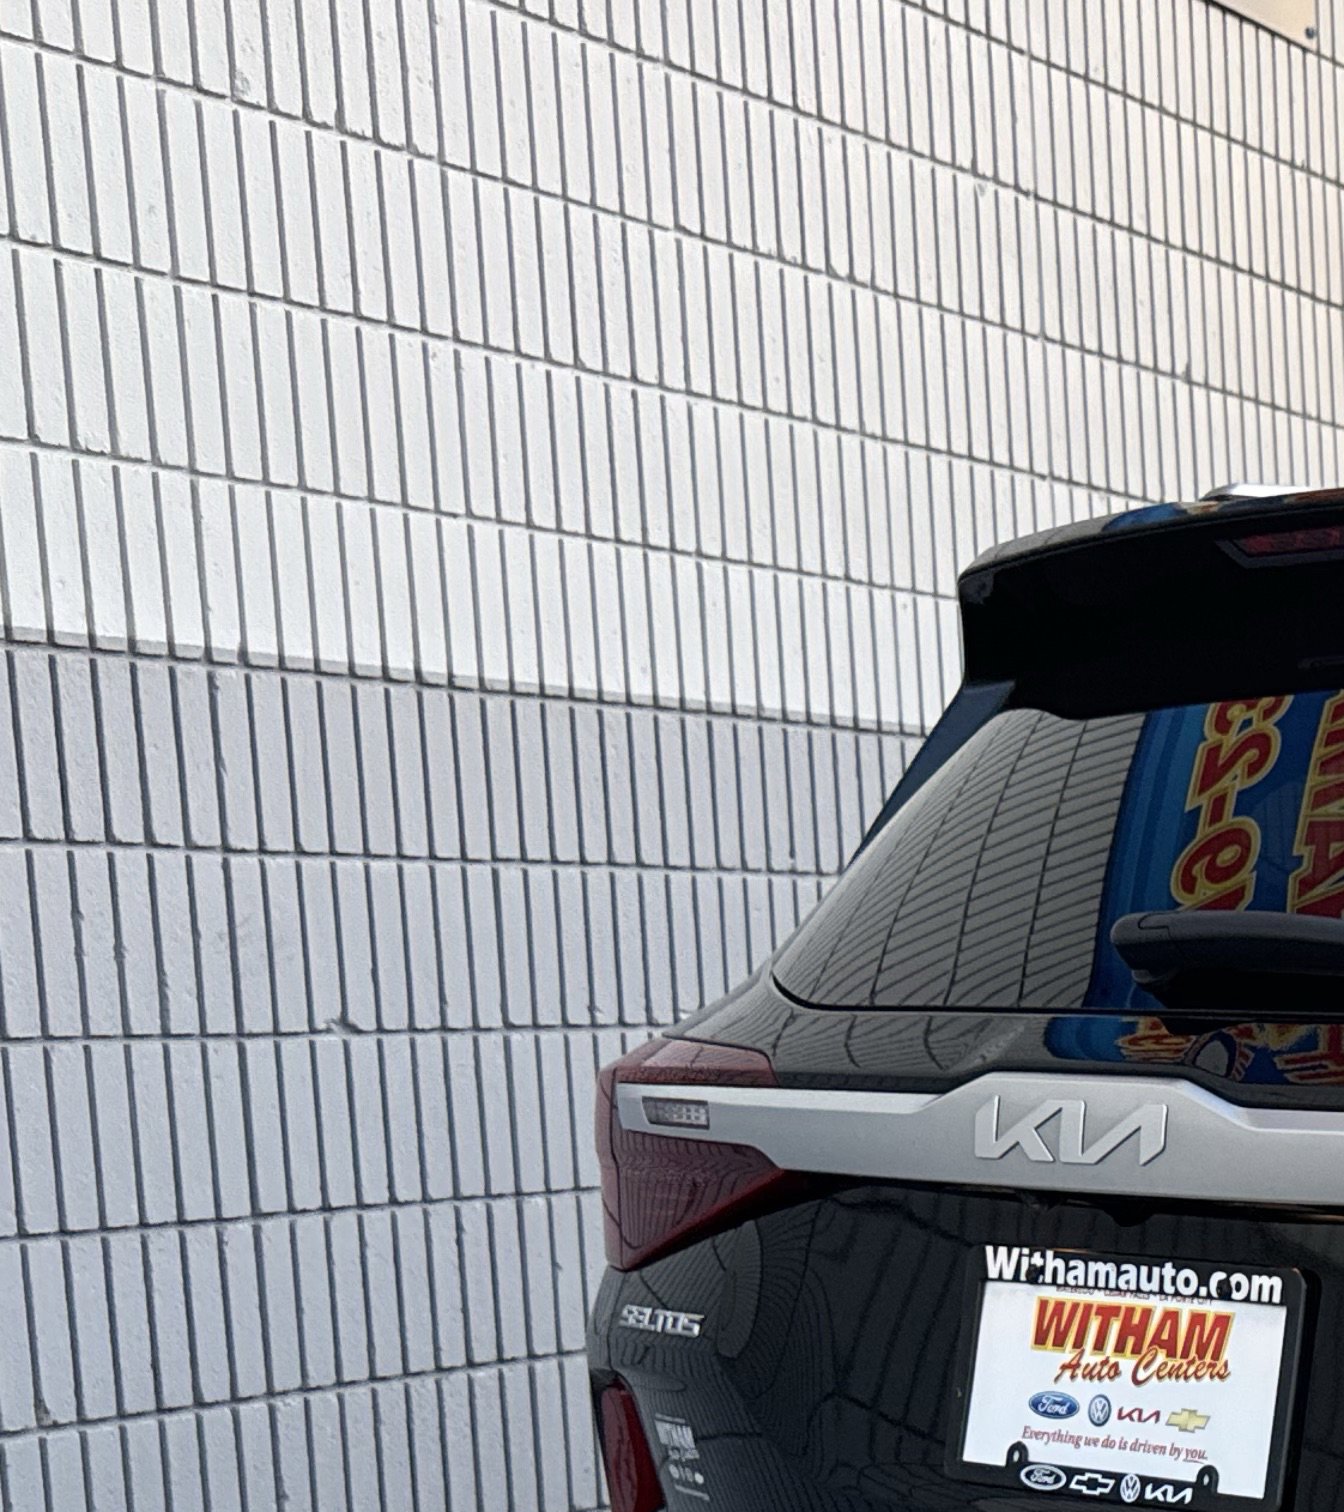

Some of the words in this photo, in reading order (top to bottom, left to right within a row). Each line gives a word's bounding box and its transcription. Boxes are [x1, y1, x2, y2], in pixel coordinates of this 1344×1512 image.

[974, 1095, 1169, 1166] KIA
[1032, 1297, 1236, 1362] WITHAM
[1054, 1348, 1122, 1384] Auto
[1131, 1347, 1231, 1388] Centers
[1033, 1394, 1073, 1417] Ford
[1117, 1406, 1161, 1424] KIA
[1022, 1425, 1082, 1449] Everything
[1084, 1434, 1100, 1448] we
[1101, 1435, 1116, 1450] do
[1117, 1436, 1128, 1450] is
[1129, 1438, 1167, 1456] driven
[1169, 1442, 1183, 1461] by
[1144, 1482, 1193, 1504] KIA
